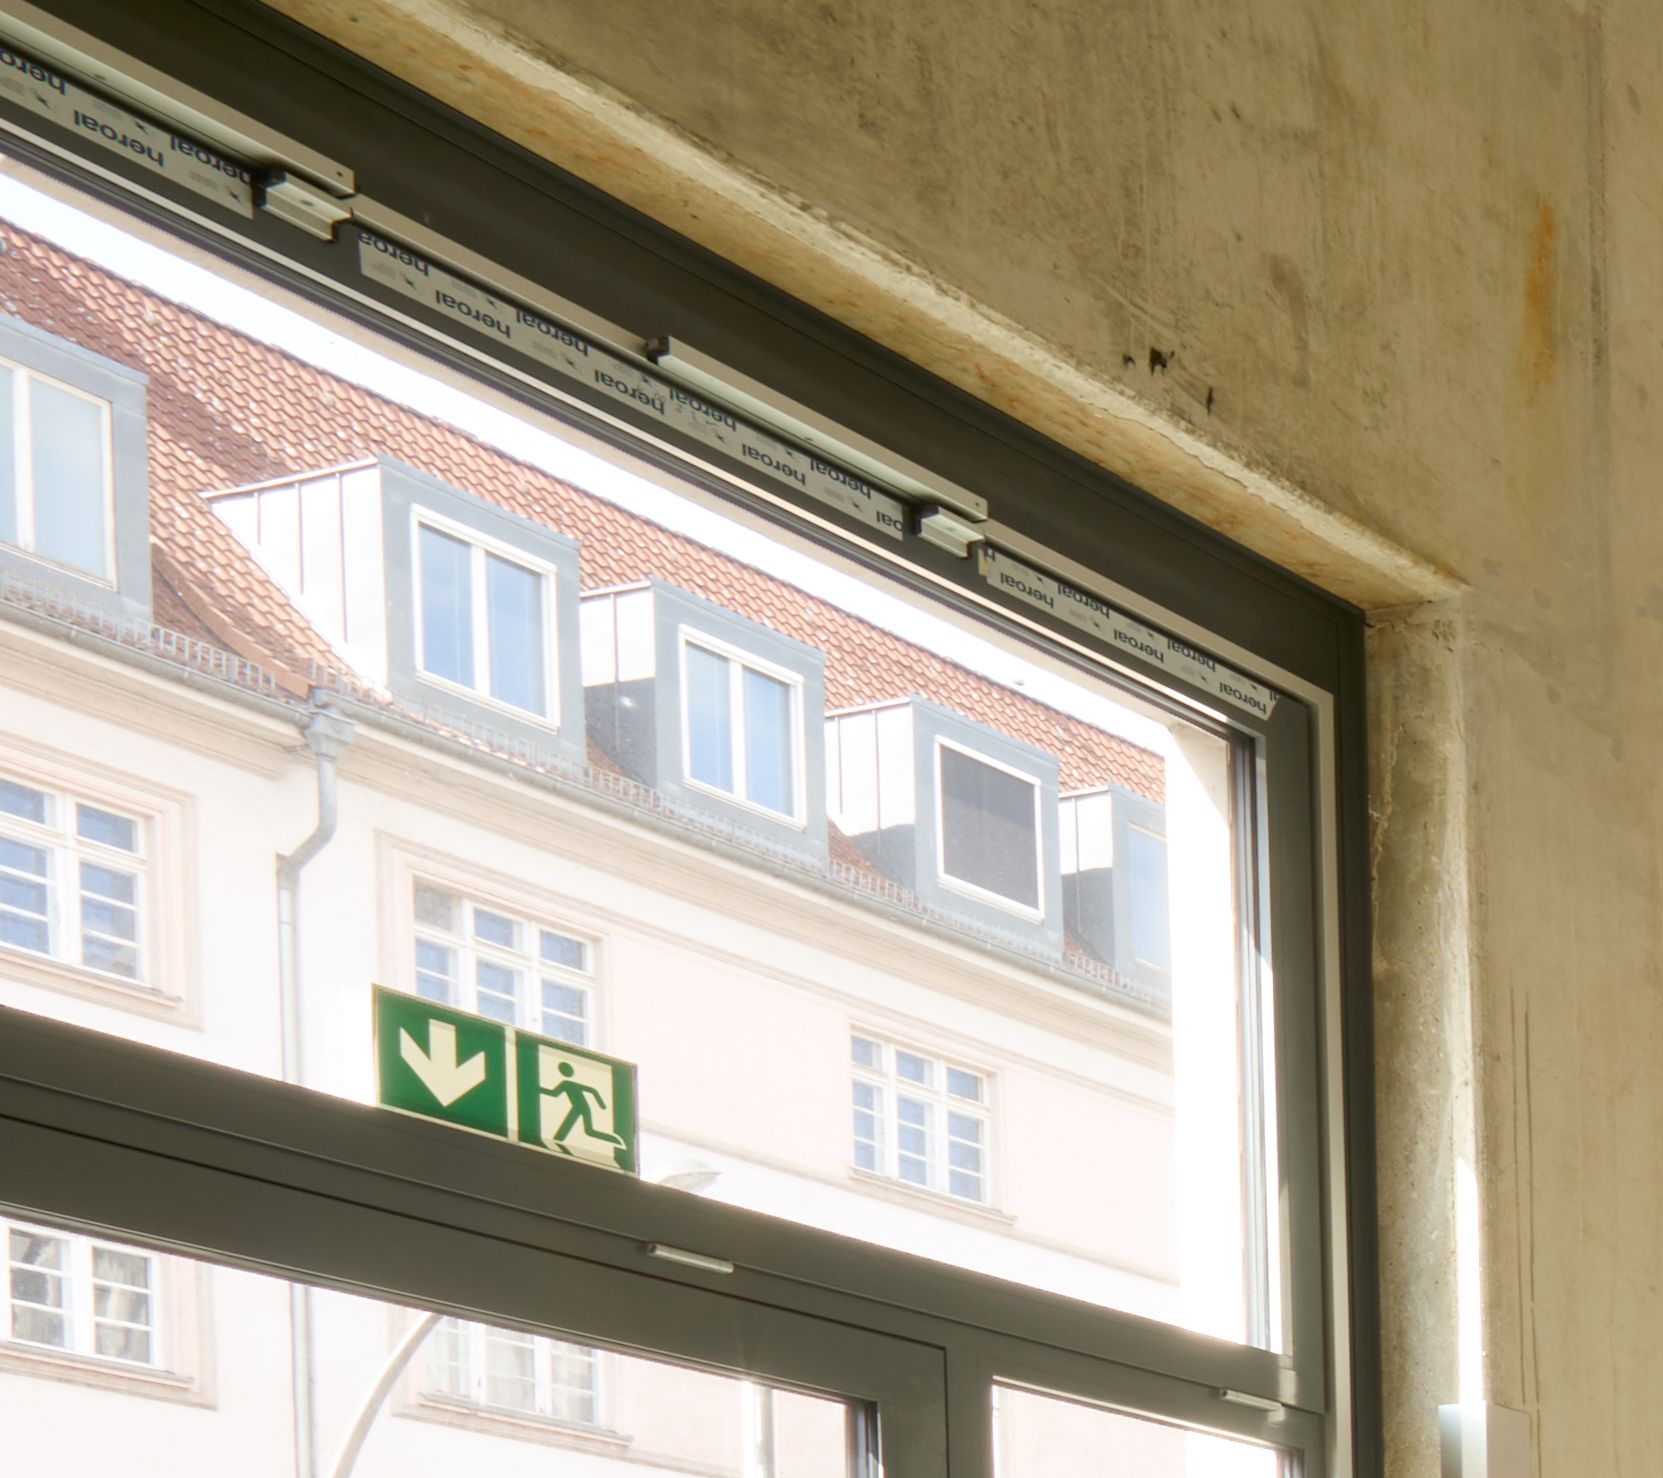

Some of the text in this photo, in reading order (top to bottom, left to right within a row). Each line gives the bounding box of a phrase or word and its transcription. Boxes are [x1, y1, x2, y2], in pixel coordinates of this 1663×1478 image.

[0, 52, 67, 96] hero
[72, 108, 165, 169] heroal
[357, 230, 430, 278] heroa
[435, 289, 512, 340] heroal
[516, 307, 590, 358] heroal
[594, 368, 666, 417] heroal
[668, 386, 738, 433] heroal
[742, 442, 807, 487] heroal
[810, 456, 873, 500] heroal
[1000, 572, 1055, 610] heroal
[1056, 583, 1111, 620] heroal
[1113, 628, 1165, 665] heroal
[1166, 638, 1217, 673] heroal
[1218, 681, 1268, 715] heroal
